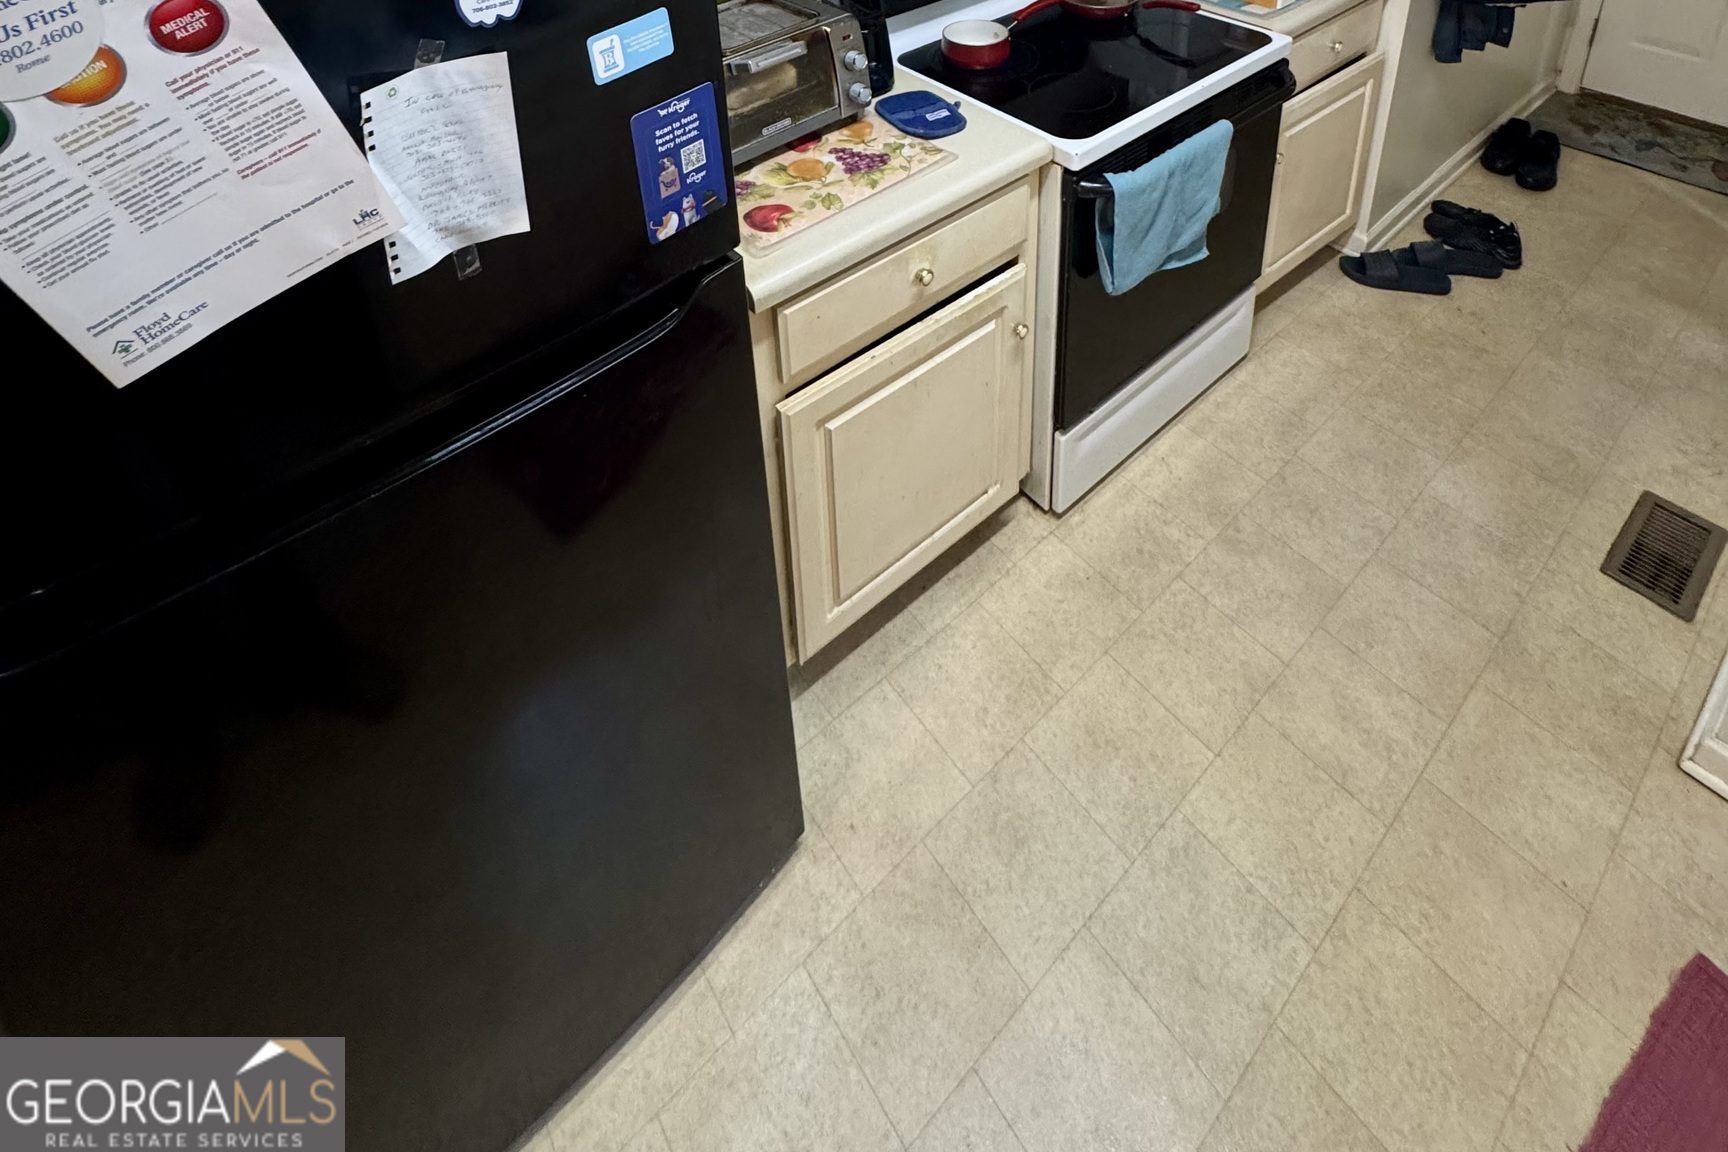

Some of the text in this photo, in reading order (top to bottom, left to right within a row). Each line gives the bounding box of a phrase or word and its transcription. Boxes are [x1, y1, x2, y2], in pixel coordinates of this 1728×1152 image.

[24, 0, 78, 32] First
[160, 8, 210, 35] MEDICAL
[174, 18, 207, 40] ALERT
[15, 54, 51, 74] Rome
[668, 99, 690, 113] Kroger
[655, 126, 672, 137] Scan
[681, 113, 698, 124] fetch
[656, 120, 699, 145] faves for your
[658, 130, 700, 152] furry friends.
[686, 170, 706, 184] Kroger
[133, 312, 171, 338] Floyd
[140, 302, 209, 345] HomeCare
